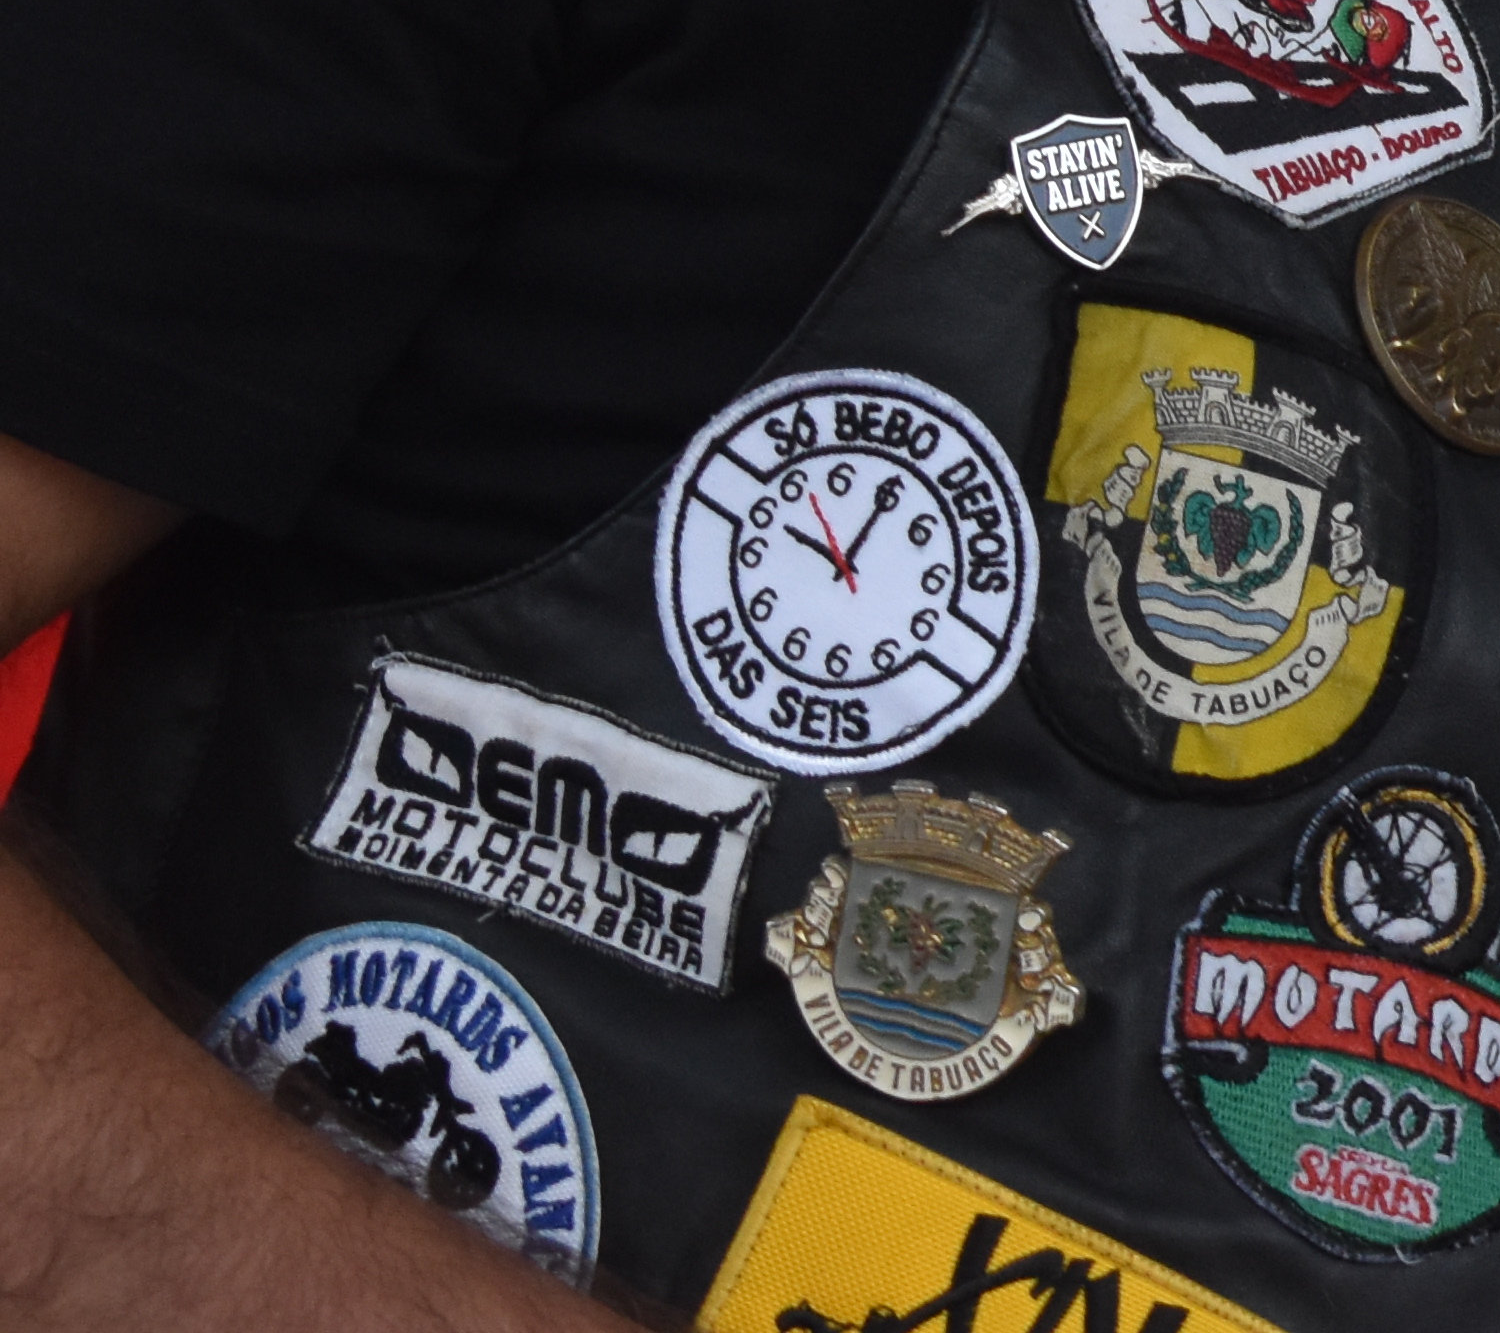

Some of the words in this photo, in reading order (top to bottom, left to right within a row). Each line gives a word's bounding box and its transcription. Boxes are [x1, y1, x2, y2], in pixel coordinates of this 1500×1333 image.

[1026, 134, 1123, 180] STAYIN'
[1252, 144, 1368, 203] TABUAÇO
[1381, 121, 1463, 161] DOURO
[1047, 169, 1125, 212] ALIVE
[764, 400, 818, 458] SÓ
[833, 400, 941, 460] BEBO
[936, 457, 1011, 595] DEPOIS
[781, 469, 808, 501] 6
[828, 463, 856, 496] 6
[750, 497, 778, 529] 6
[908, 514, 937, 546] 6
[740, 537, 769, 568] 6
[921, 564, 950, 595] 6
[750, 587, 778, 621] 6
[910, 608, 939, 641] 6
[783, 628, 811, 661] 6
[825, 644, 852, 677] 6
[871, 639, 901, 671] 6
[1093, 591, 1130, 668] VILA
[1135, 668, 1172, 705] DE
[1190, 645, 1326, 716] TABUAÇO
[693, 607, 766, 700] DAS
[770, 686, 871, 743] SEIS
[349, 789, 706, 945] MOTOCLUBE
[536, 881, 586, 924] DA
[593, 906, 703, 976] BEIRA
[321, 949, 529, 1074] MOTARDS
[804, 992, 854, 1052] VILA
[848, 1045, 884, 1082] DE
[890, 1034, 1013, 1094] TABUAÇO
[1294, 1060, 1462, 1162] 2001
[1293, 1143, 1440, 1227] SAGRES
